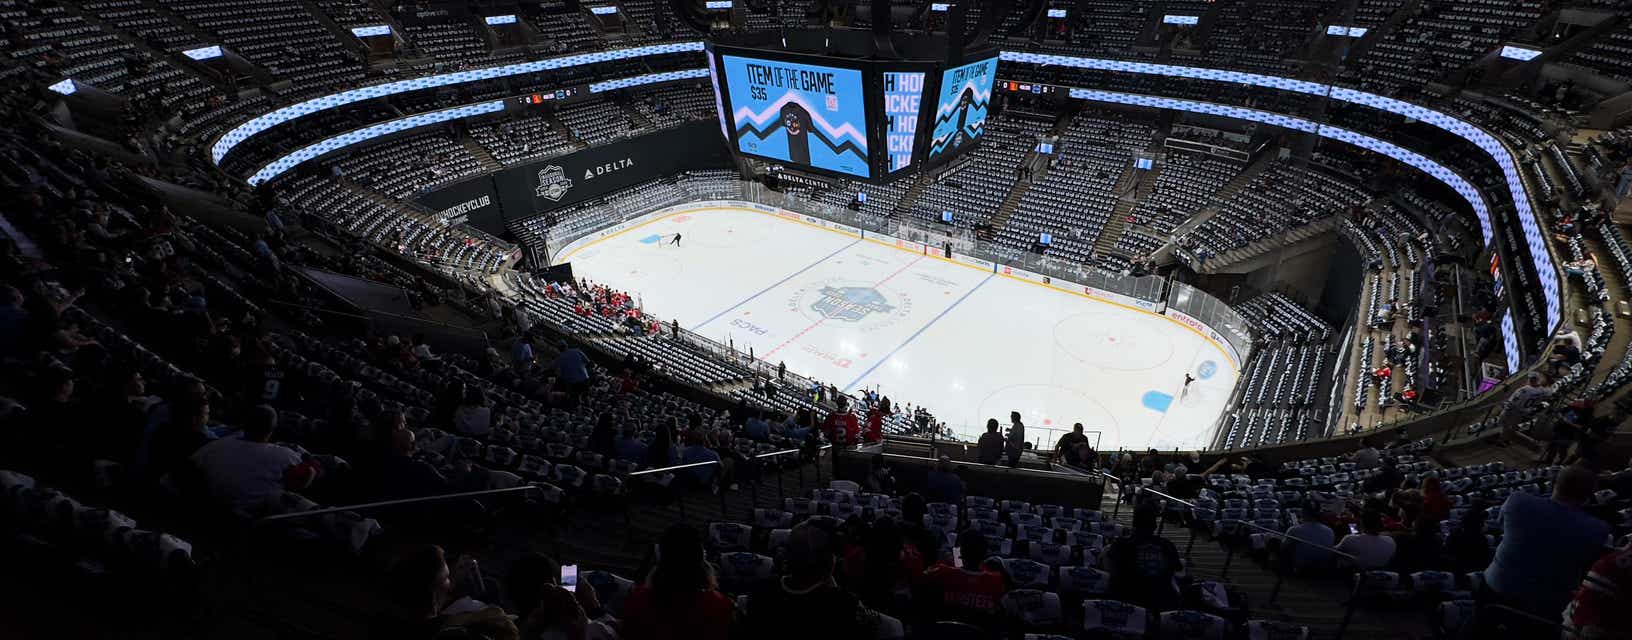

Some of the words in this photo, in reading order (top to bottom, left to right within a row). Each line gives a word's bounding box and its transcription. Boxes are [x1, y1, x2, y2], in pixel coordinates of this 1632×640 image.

[746, 63, 774, 87] ITEM
[774, 67, 784, 88] OF
[784, 68, 800, 90] THE
[800, 70, 836, 95] GAME
[885, 74, 894, 92] H
[899, 74, 925, 93] HO
[750, 85, 767, 101] $35
[596, 158, 634, 176] DELTA
[783, 174, 804, 184] DELTA
[804, 179, 829, 189] CENTER
[730, 318, 768, 336] PACS
